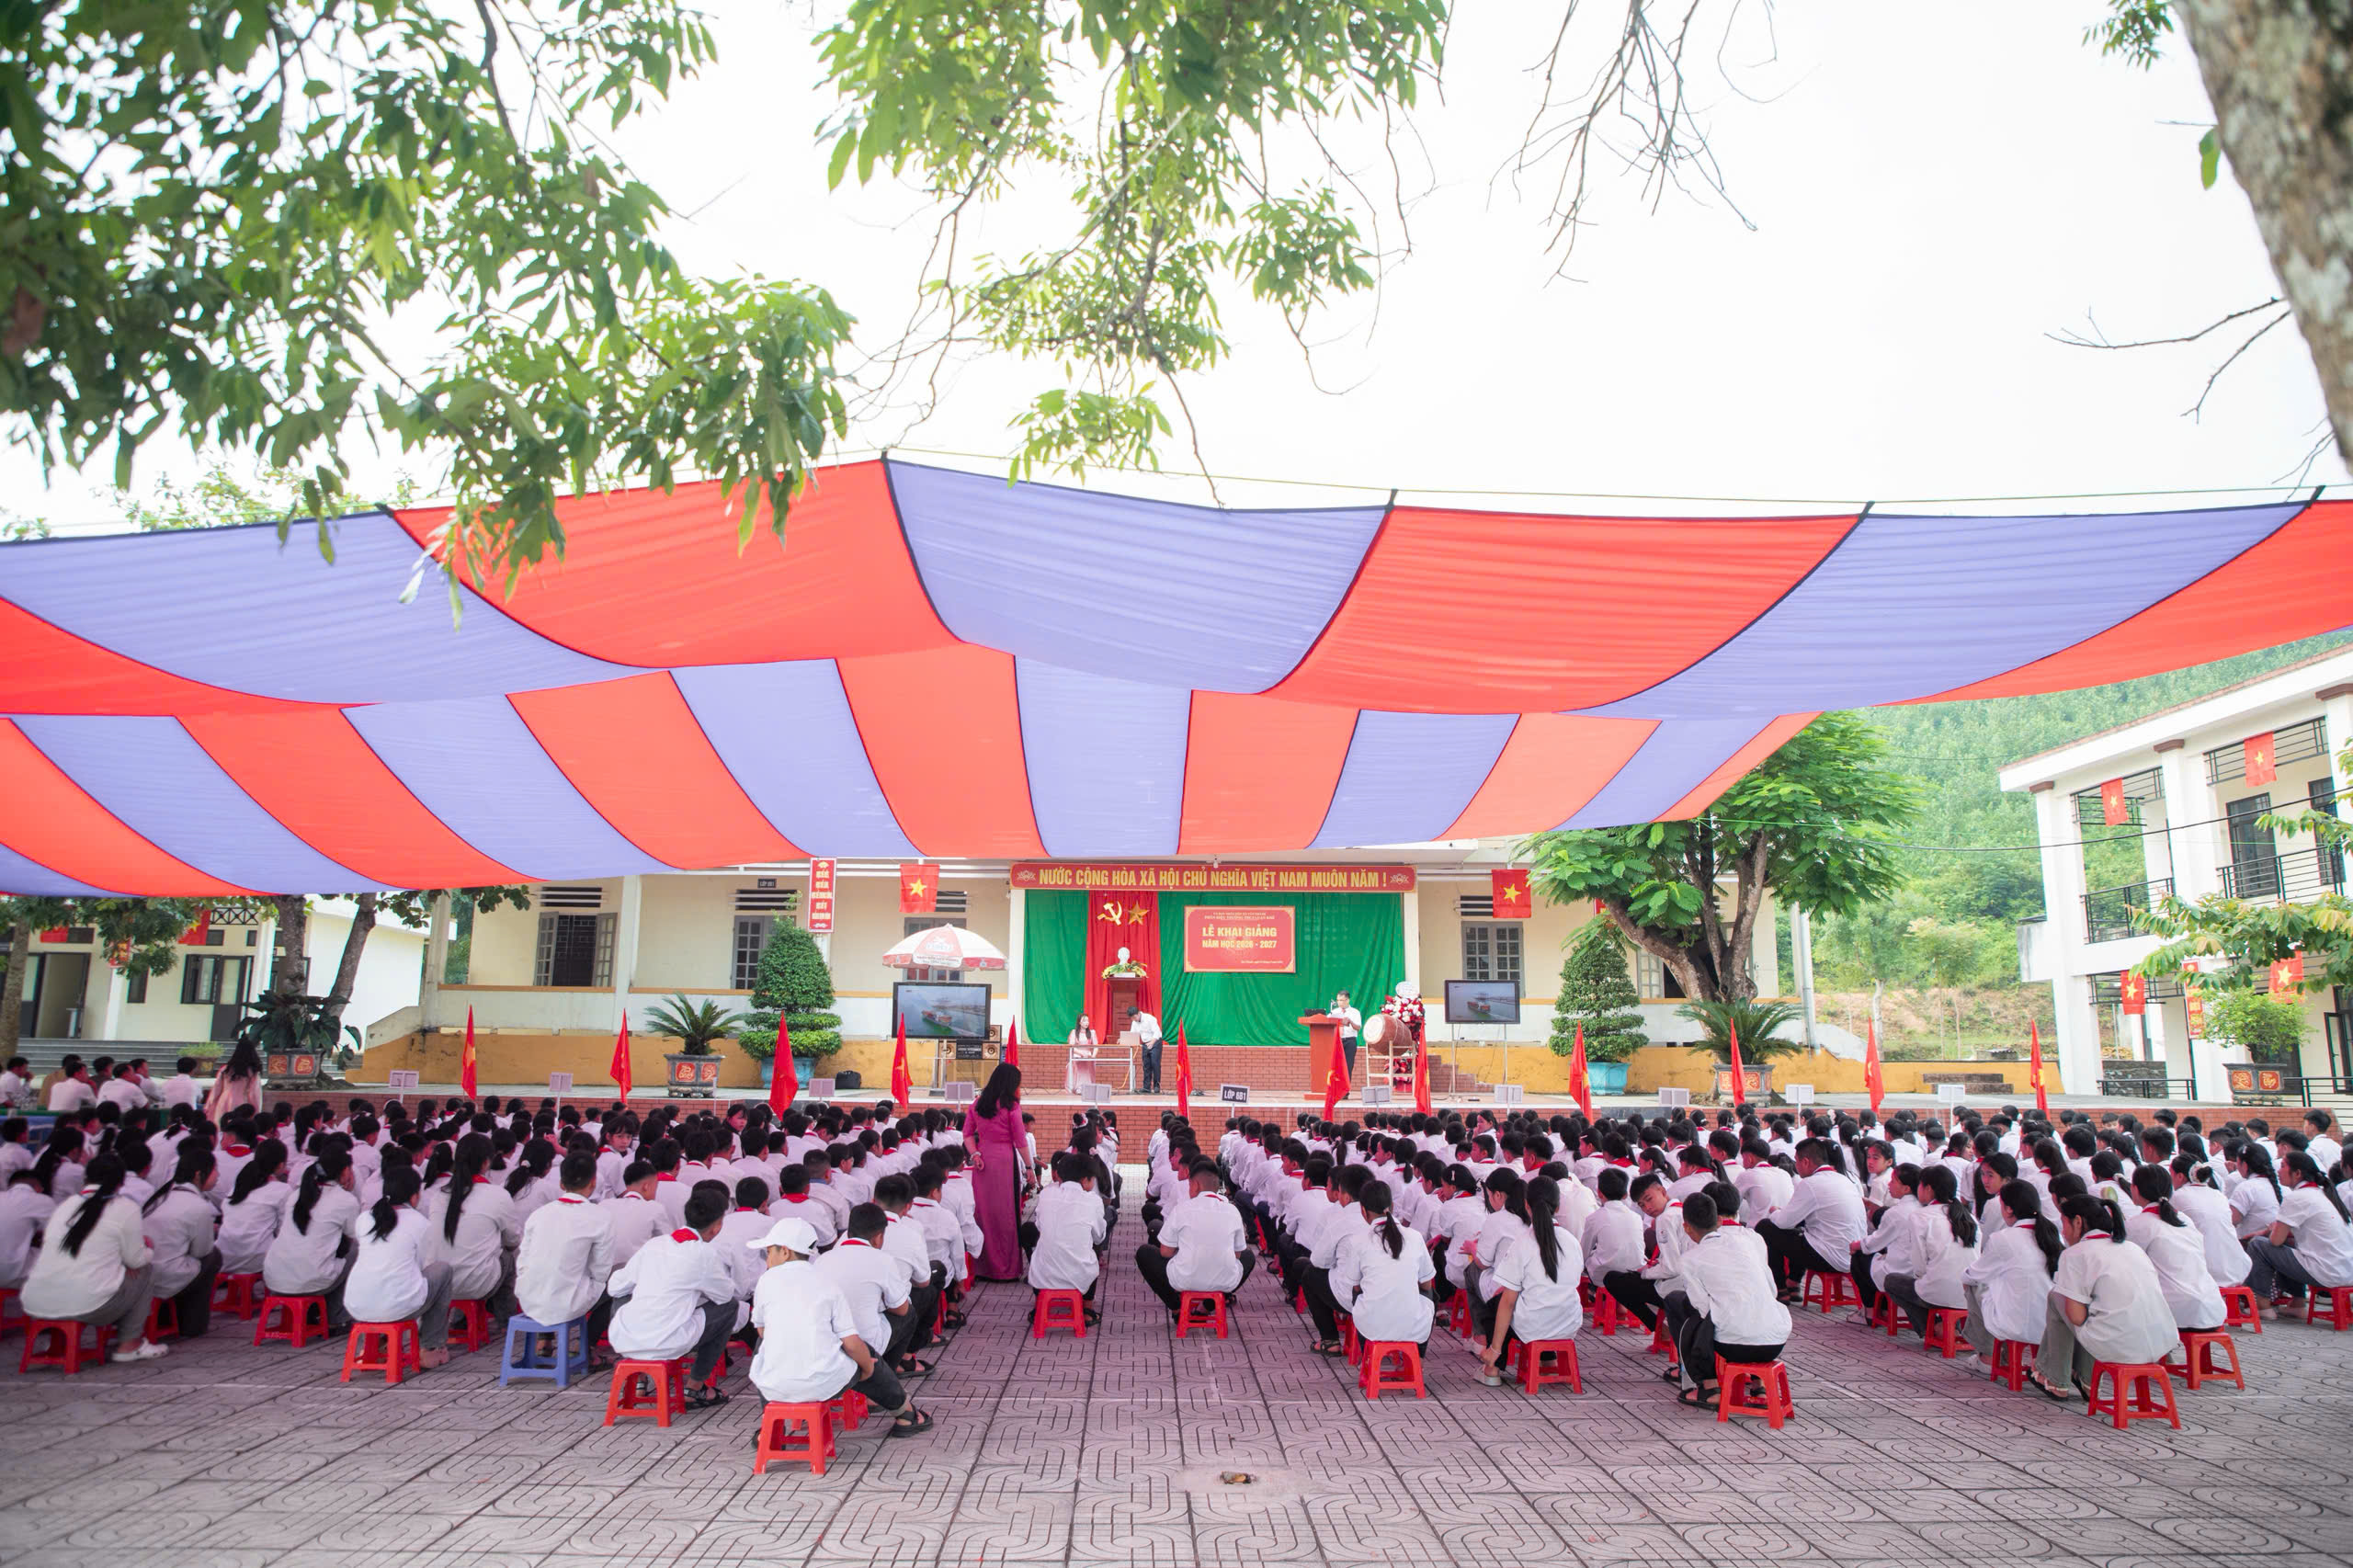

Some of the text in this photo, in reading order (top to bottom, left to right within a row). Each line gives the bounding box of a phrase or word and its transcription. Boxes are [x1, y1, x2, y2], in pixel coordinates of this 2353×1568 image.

[1039, 866, 1387, 891] NƯỚC CỘNG HÒA XÃ HỘI CHỦ NGHĨA VIỆT NAM MUÔN NĂM !
[1202, 924, 1277, 937] LỄ KHAI GIẢNG
[1202, 938, 1219, 948] NĂM
[1221, 940, 1234, 949] HỌC
[1223, 1089, 1235, 1099] LỚP
